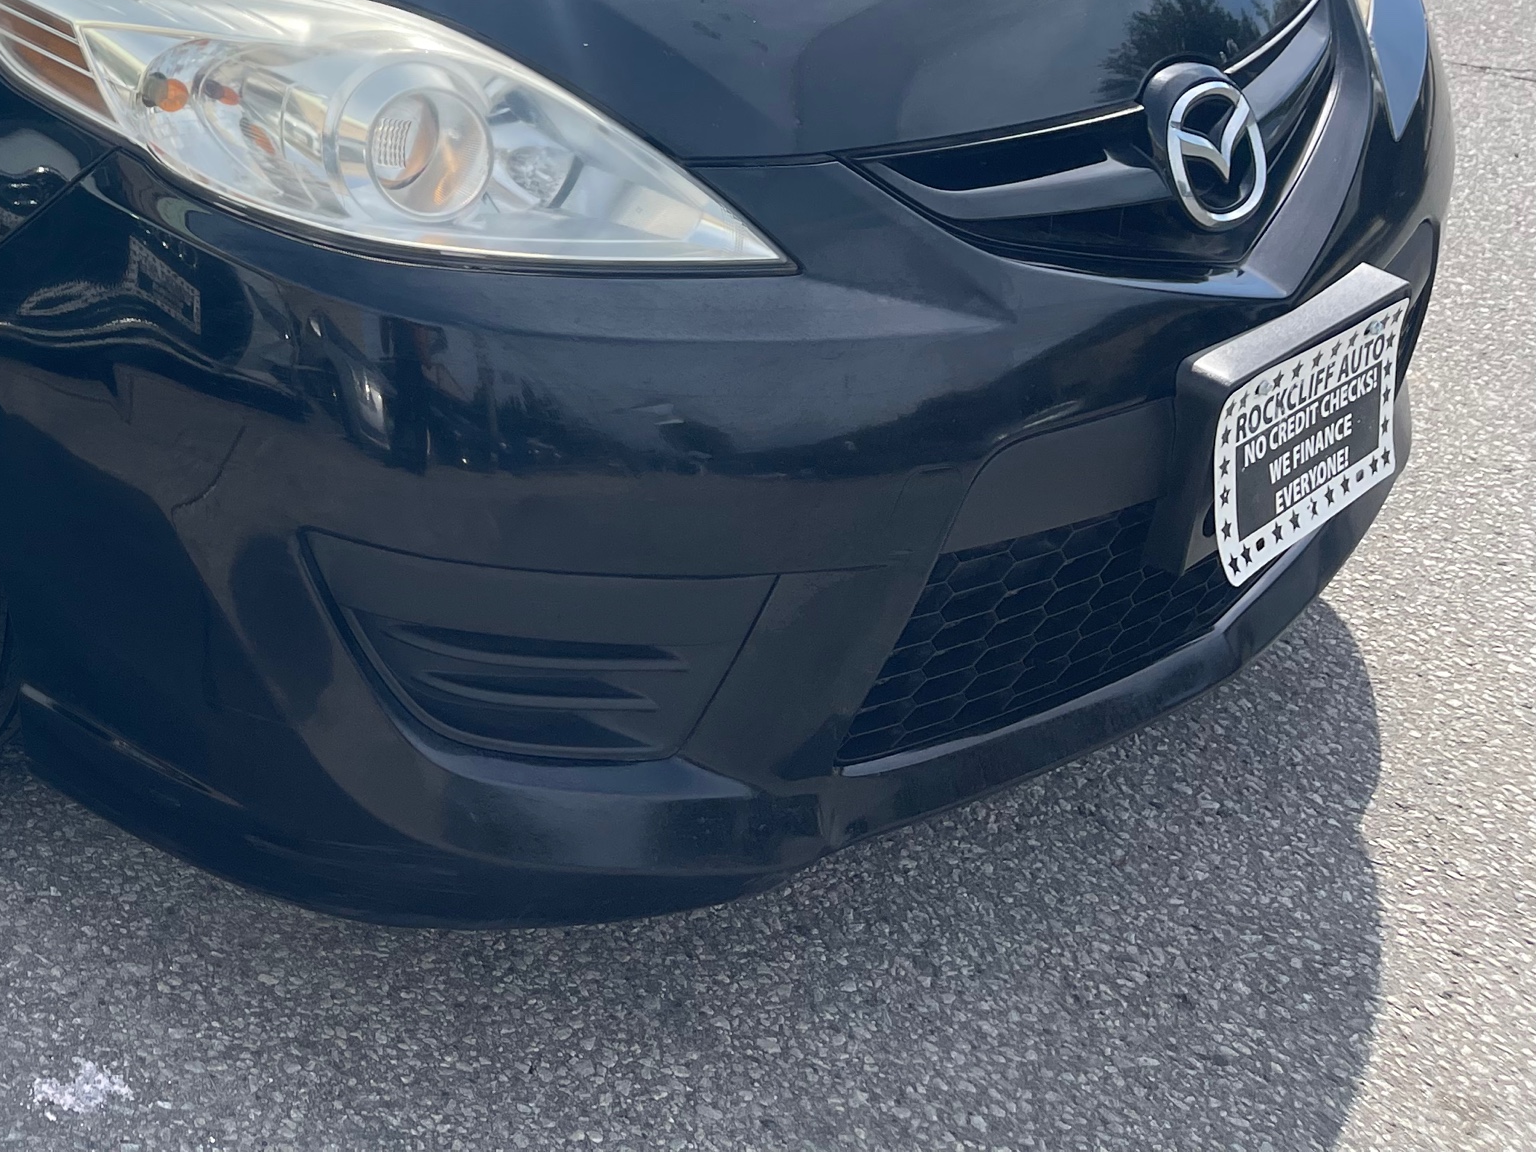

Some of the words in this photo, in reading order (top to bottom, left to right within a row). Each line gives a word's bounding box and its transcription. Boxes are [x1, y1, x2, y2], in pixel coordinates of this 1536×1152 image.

[1236, 360, 1336, 442] ROCKCLIFF
[1338, 333, 1386, 378] AUTO
[1243, 436, 1267, 468] NO
[1268, 403, 1320, 450] CREDIT
[1320, 367, 1379, 418] CHECKS!
[1268, 457, 1293, 485] WE
[1292, 413, 1353, 472] FINANCE
[1274, 446, 1350, 515] EVERYONE!
